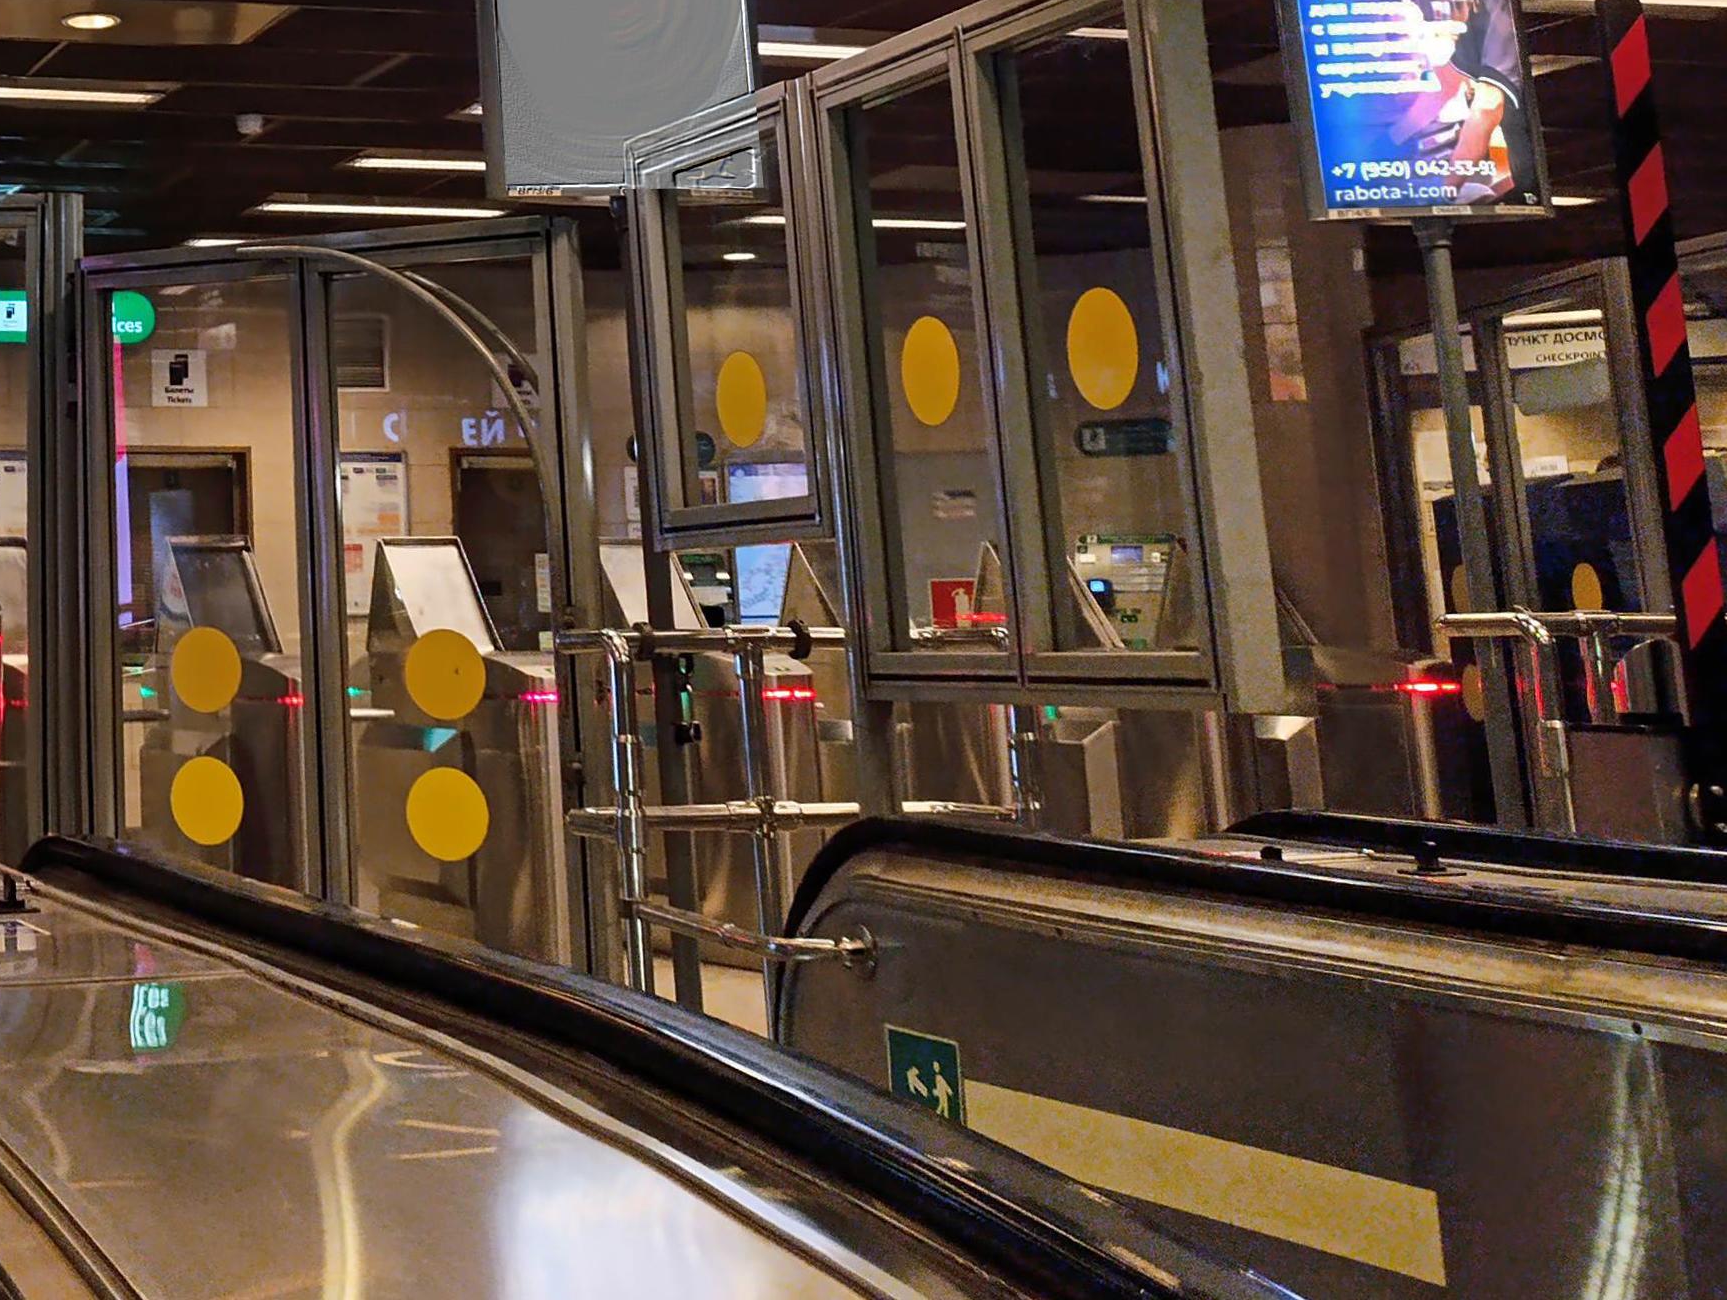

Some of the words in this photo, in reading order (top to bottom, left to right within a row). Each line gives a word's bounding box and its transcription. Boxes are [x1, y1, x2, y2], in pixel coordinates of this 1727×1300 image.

[1361, 160, 1410, 181] (950)
[1335, 183, 1457, 202] rabota-i.com
[1535, 351, 1605, 363] CHECKPOIN
